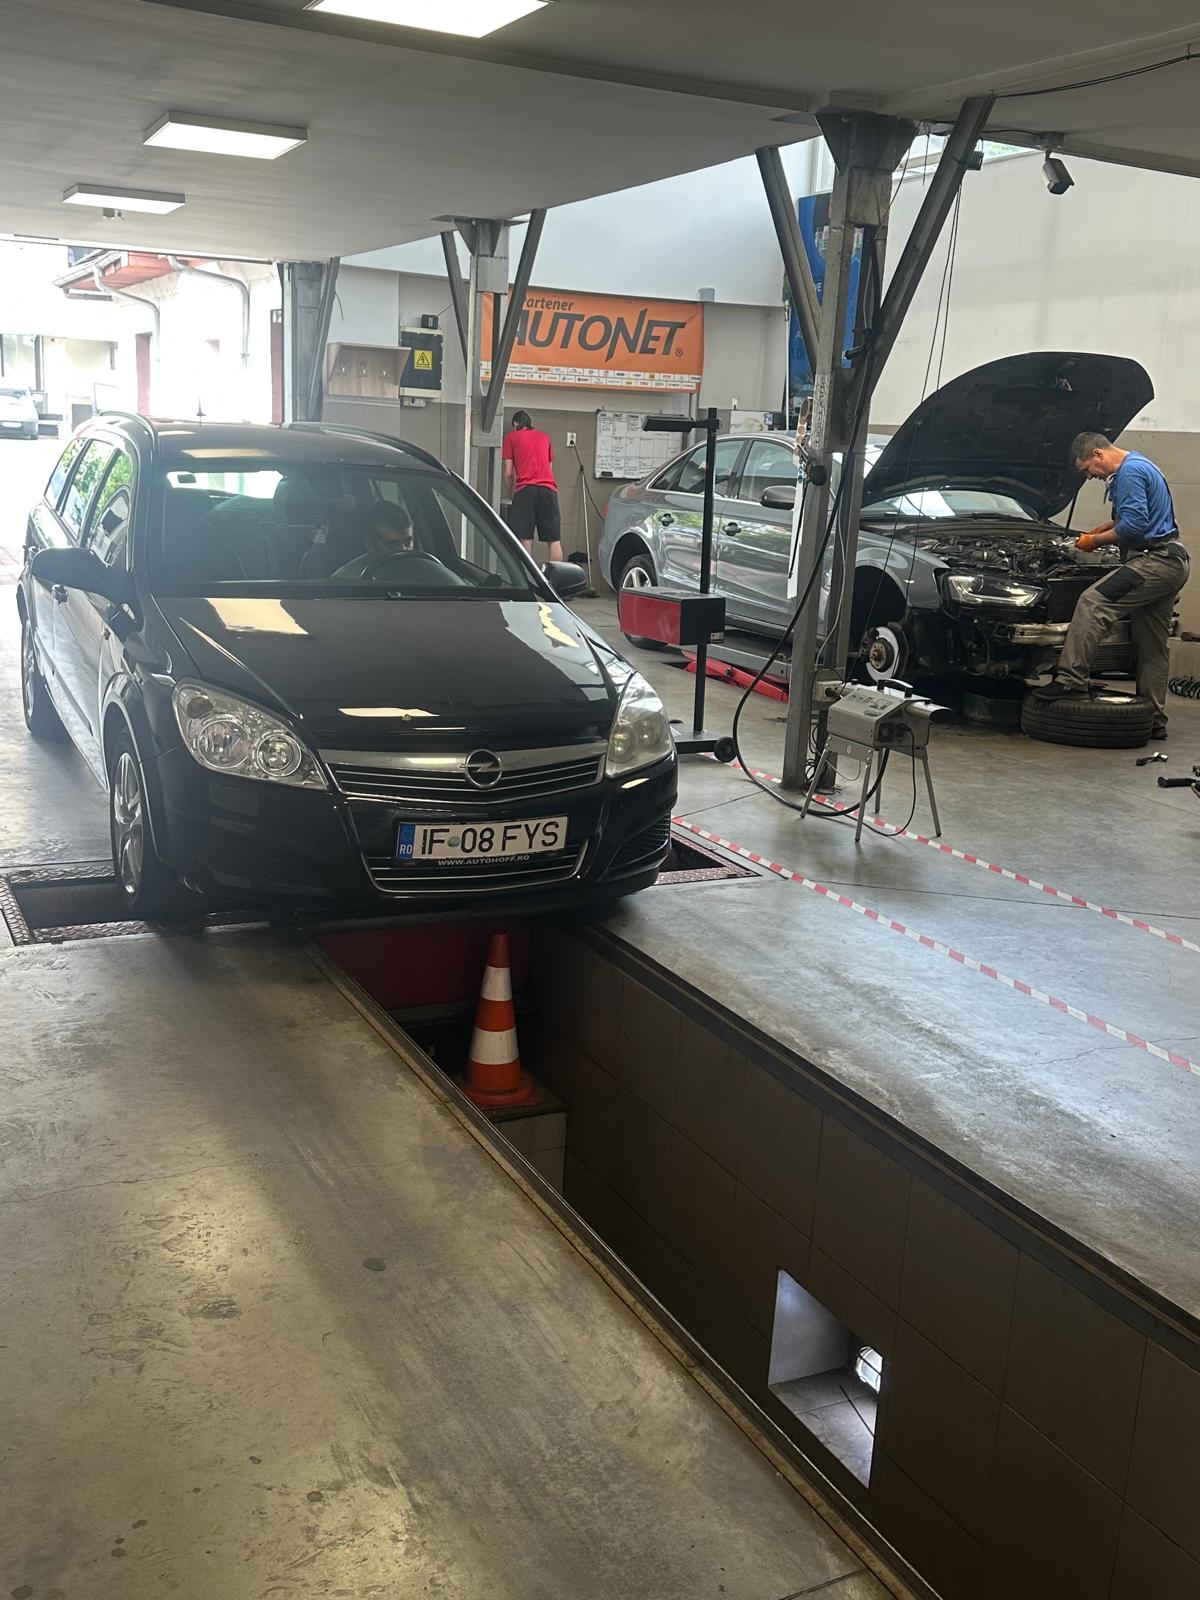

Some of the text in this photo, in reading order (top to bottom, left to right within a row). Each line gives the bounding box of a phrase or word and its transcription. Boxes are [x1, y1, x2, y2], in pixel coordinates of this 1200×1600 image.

[524, 296, 575, 311] artener
[421, 821, 560, 855] IF 08 FYS
[400, 844, 413, 855] RO
[438, 855, 530, 866] WWW.AUTOHOFF.RO
